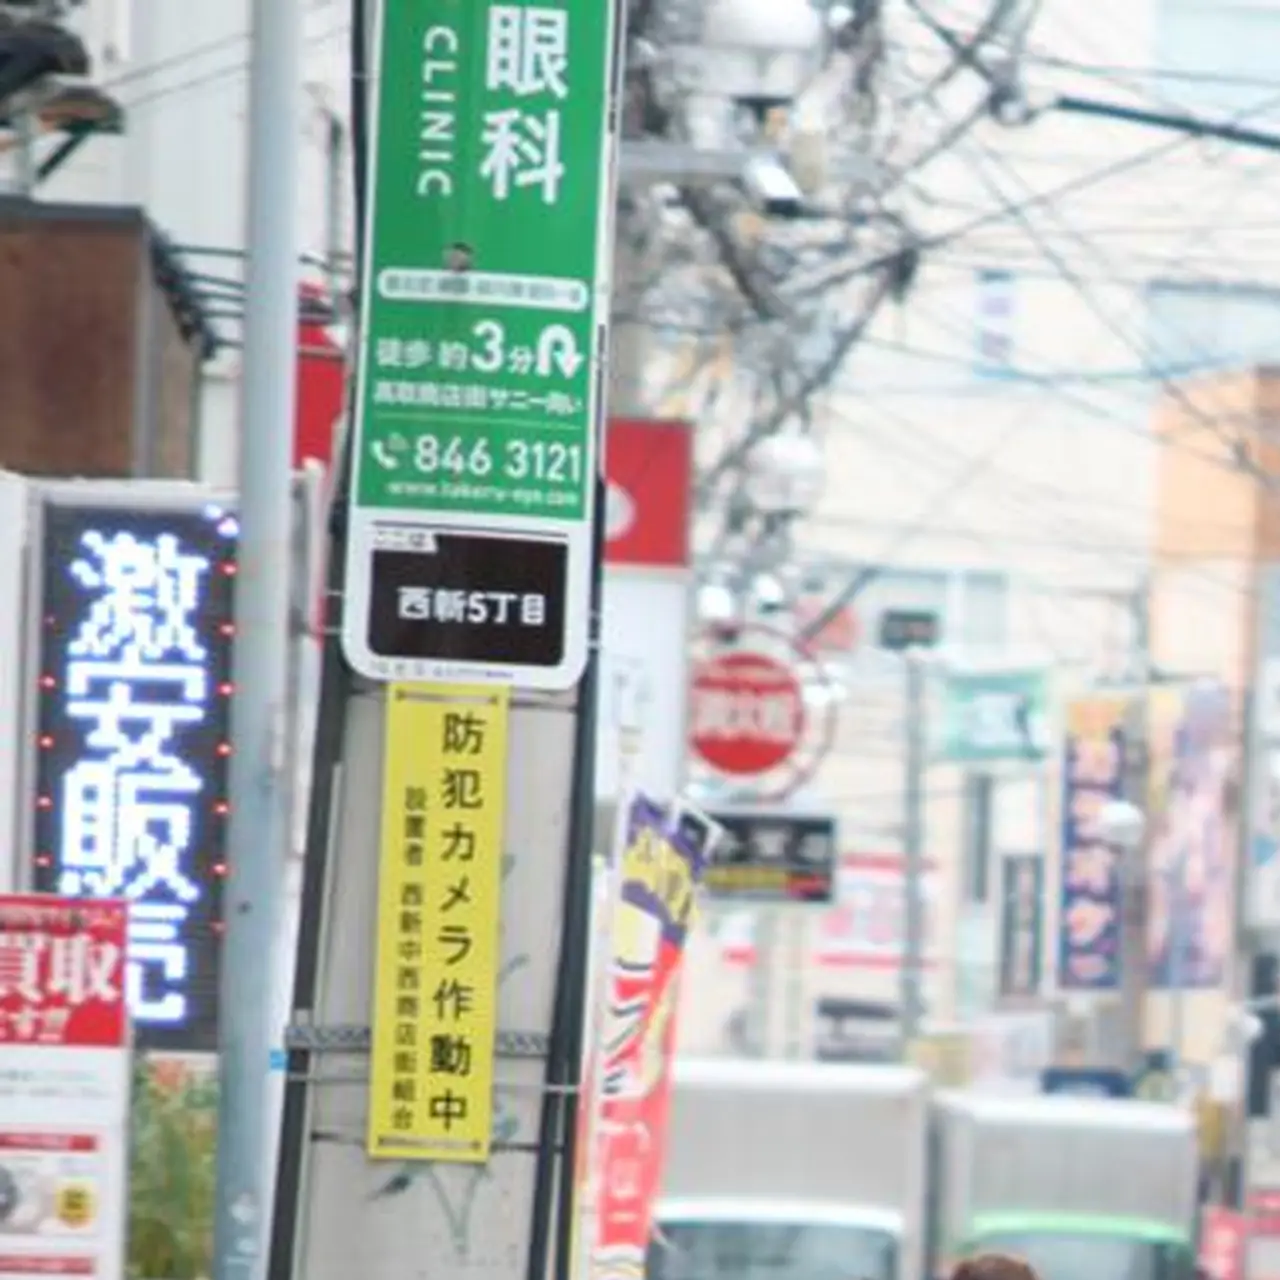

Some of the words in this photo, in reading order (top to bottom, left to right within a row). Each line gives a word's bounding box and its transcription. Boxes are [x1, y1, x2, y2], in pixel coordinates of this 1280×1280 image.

[416, 25, 459, 197] CLINIC
[479, 4, 569, 206] 眼科
[414, 432, 493, 477] 846
[504, 439, 583, 484] 3121
[397, 585, 546, 625] 西新5丁目
[430, 711, 488, 1132] 防犯カメラ作動中
